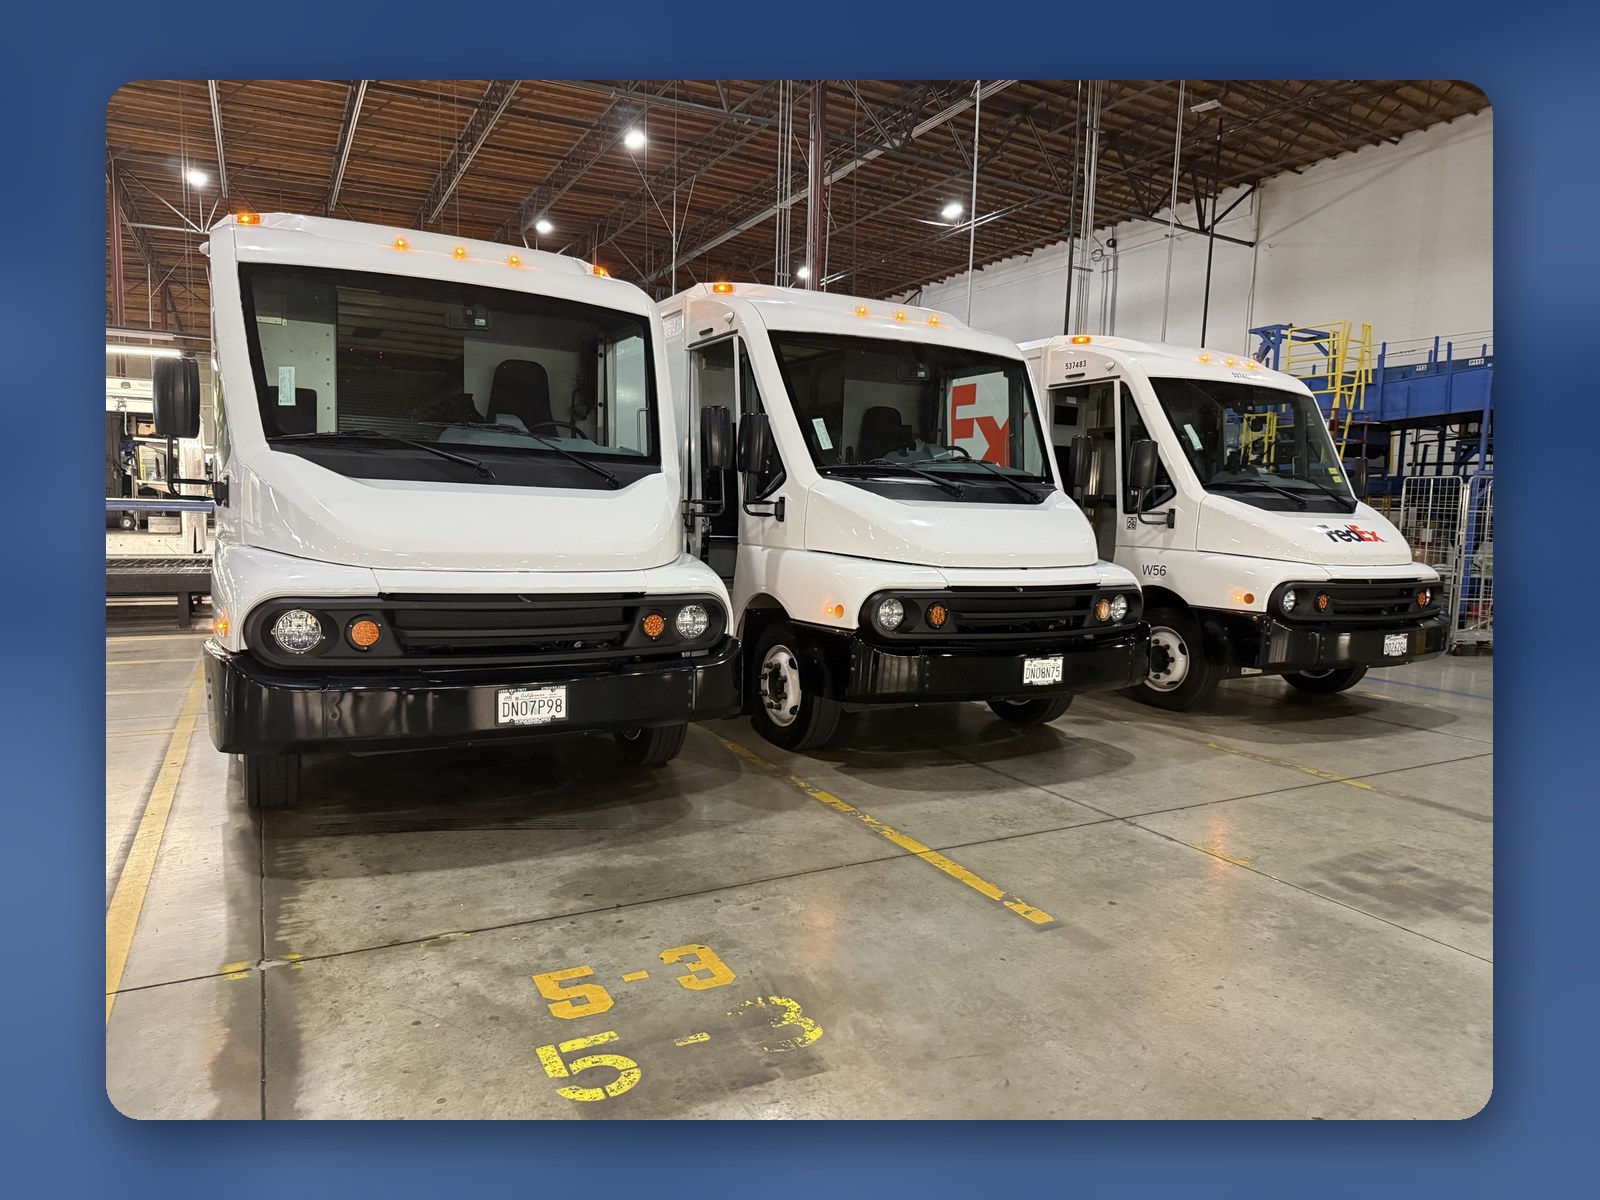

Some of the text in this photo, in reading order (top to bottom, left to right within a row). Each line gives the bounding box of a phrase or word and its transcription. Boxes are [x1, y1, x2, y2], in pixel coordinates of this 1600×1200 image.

[1065, 360, 1087, 370] 537483
[1142, 564, 1167, 577] W56
[1025, 666, 1060, 680] DN08N75
[502, 698, 563, 718] DN07P98
